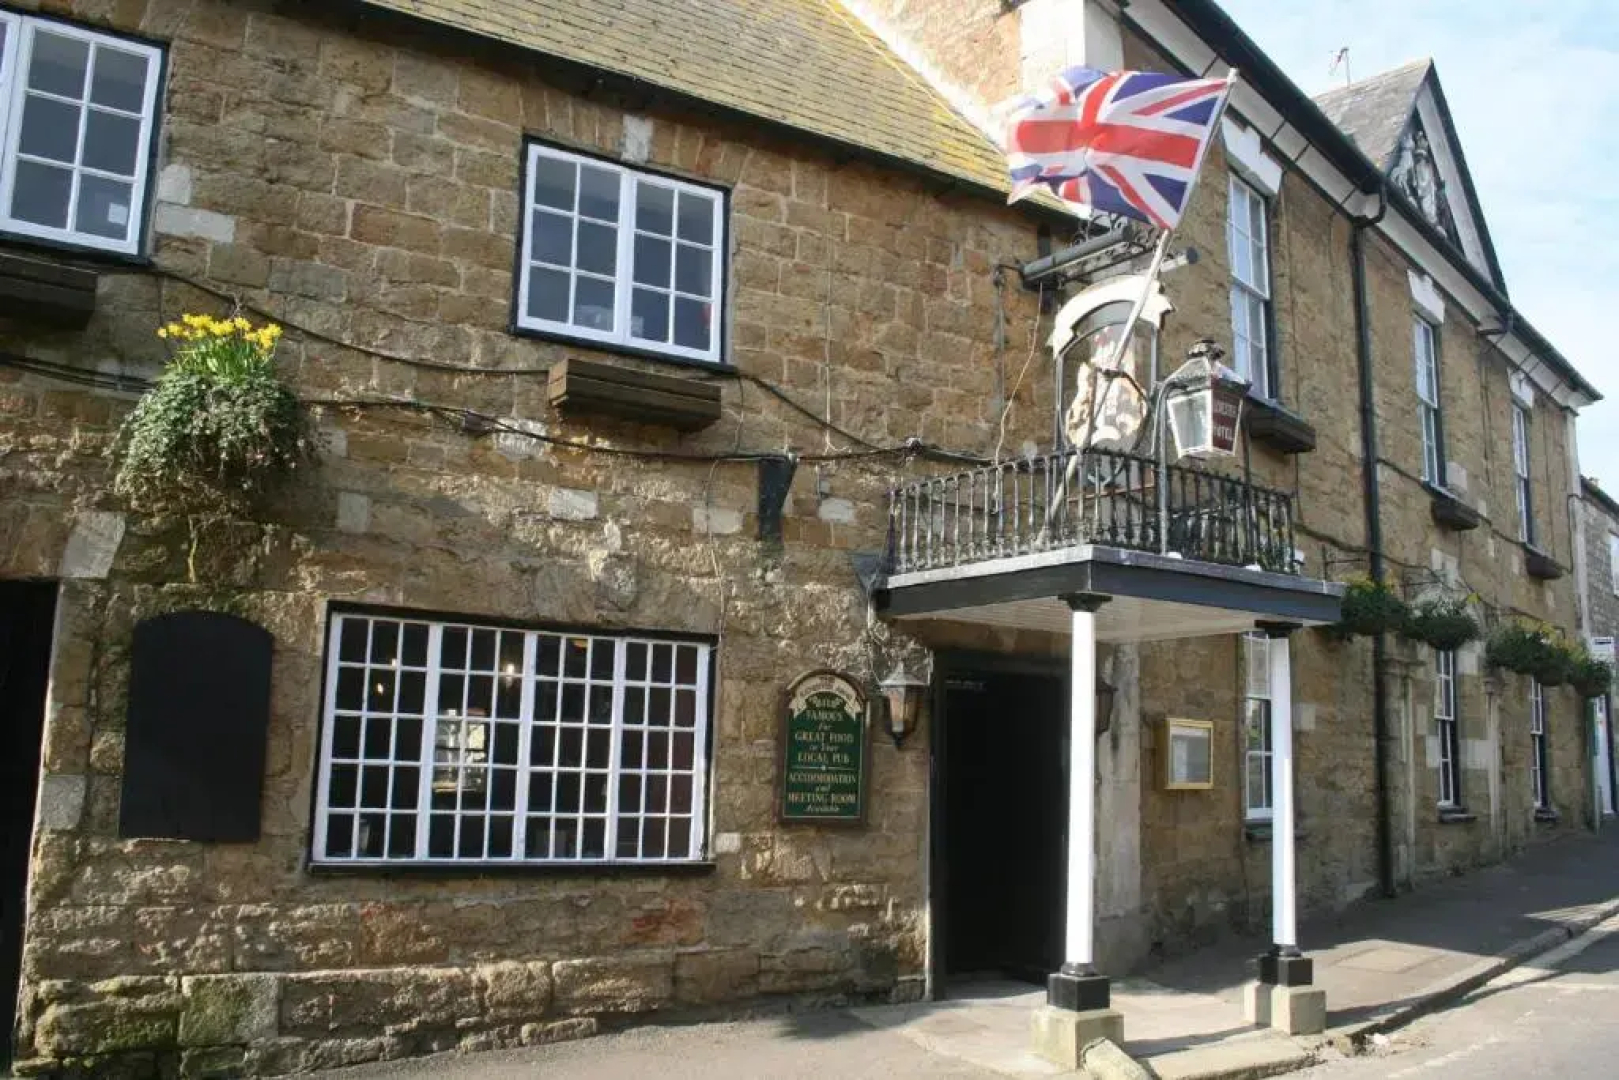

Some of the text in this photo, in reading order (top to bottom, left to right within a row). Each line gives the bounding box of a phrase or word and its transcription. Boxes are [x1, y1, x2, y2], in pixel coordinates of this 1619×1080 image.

[806, 709, 844, 721] FAMOUS
[794, 731, 854, 744] GREAT FOOD
[797, 752, 850, 764] LOCAL PUB
[788, 772, 857, 784] ACCOMMODATION
[787, 791, 856, 804] MEETING ROOM
